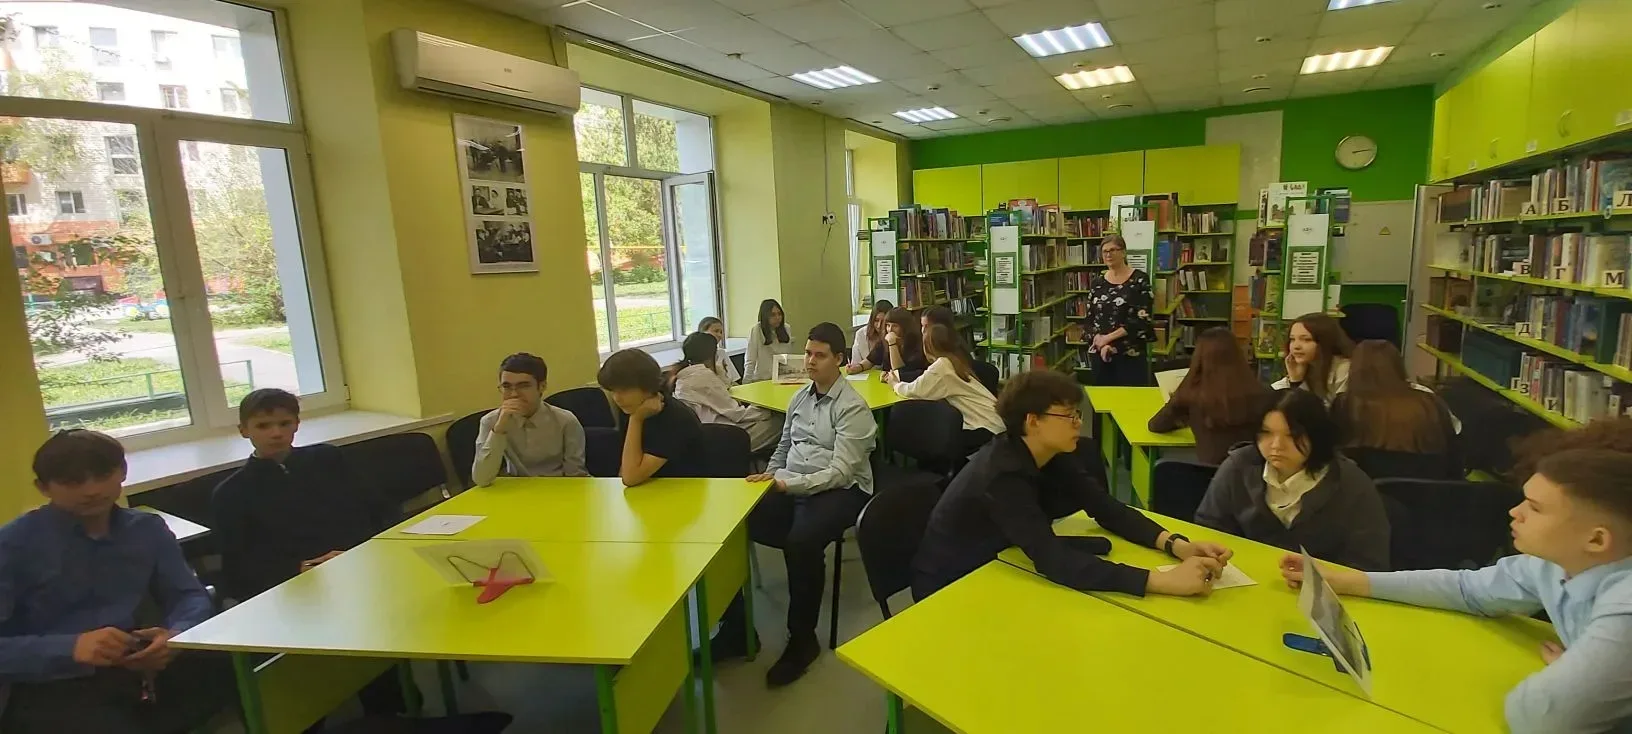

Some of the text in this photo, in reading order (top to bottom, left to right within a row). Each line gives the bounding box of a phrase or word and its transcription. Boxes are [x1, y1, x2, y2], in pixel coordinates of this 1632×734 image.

[1525, 204, 1537, 215] А
[1557, 200, 1569, 212] Б
[1521, 264, 1531, 275] В
[1556, 268, 1567, 280] Г
[1605, 272, 1625, 286] М
[1519, 323, 1531, 336] Д
[1520, 383, 1529, 394] З
